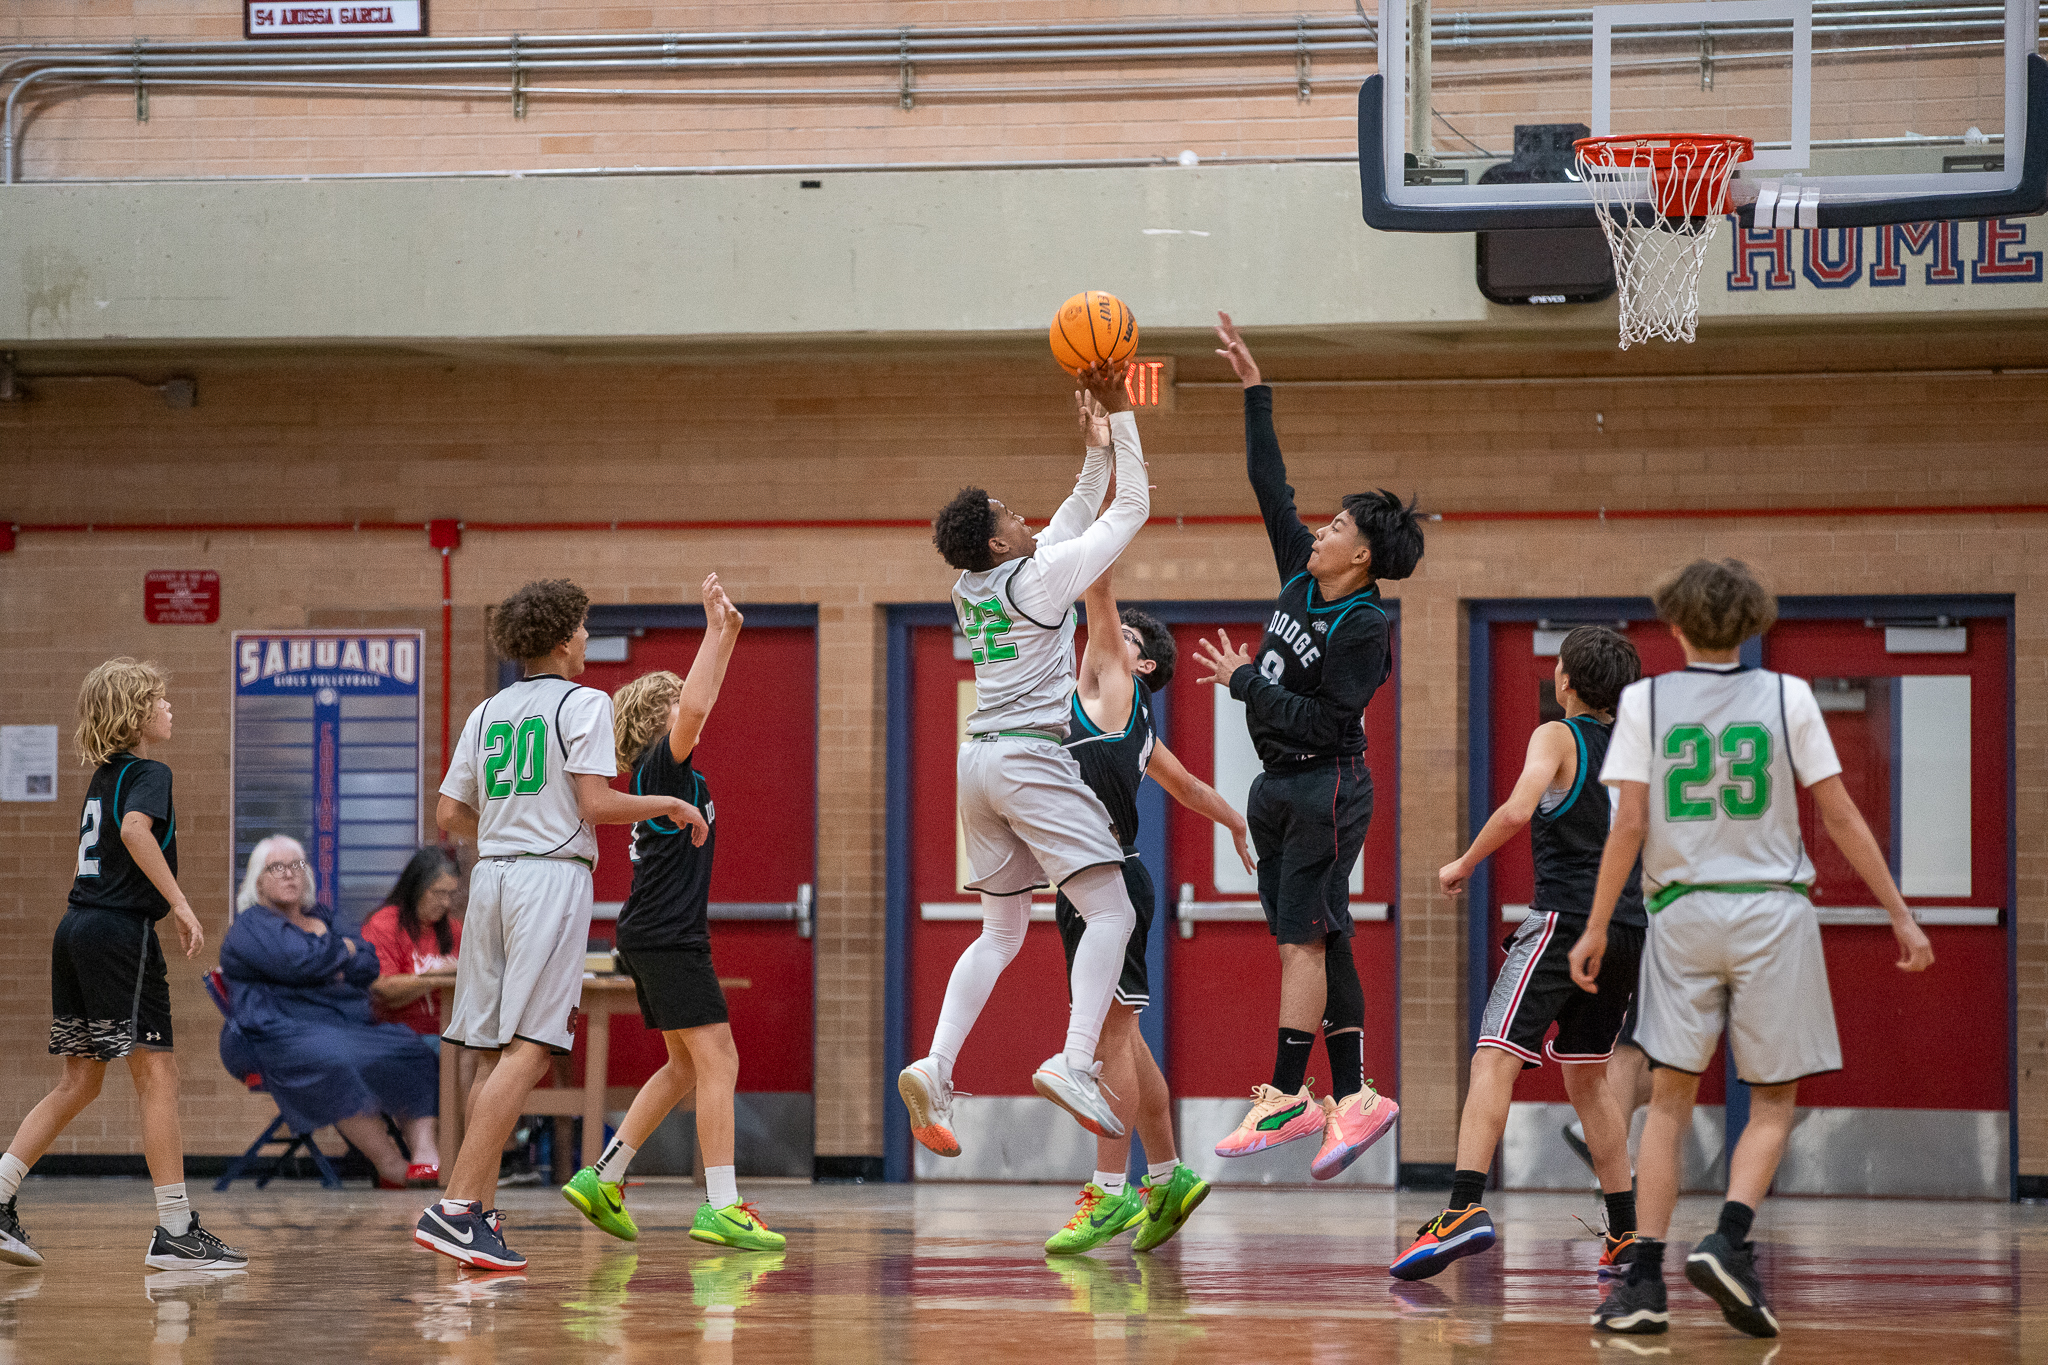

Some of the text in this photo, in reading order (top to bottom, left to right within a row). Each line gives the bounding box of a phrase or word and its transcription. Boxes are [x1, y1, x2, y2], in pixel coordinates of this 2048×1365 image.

[255, 9, 274, 25] 54
[340, 7, 394, 24] GARCIA
[1726, 213, 2043, 291] HOME
[1124, 362, 1165, 406] XIT
[239, 638, 417, 688] SAHUARO
[1267, 610, 1321, 668] DODGE
[310, 673, 381, 687] VOLLEYBALL
[483, 715, 548, 800] 20
[1663, 721, 1774, 822] 23
[77, 797, 102, 878] 2
